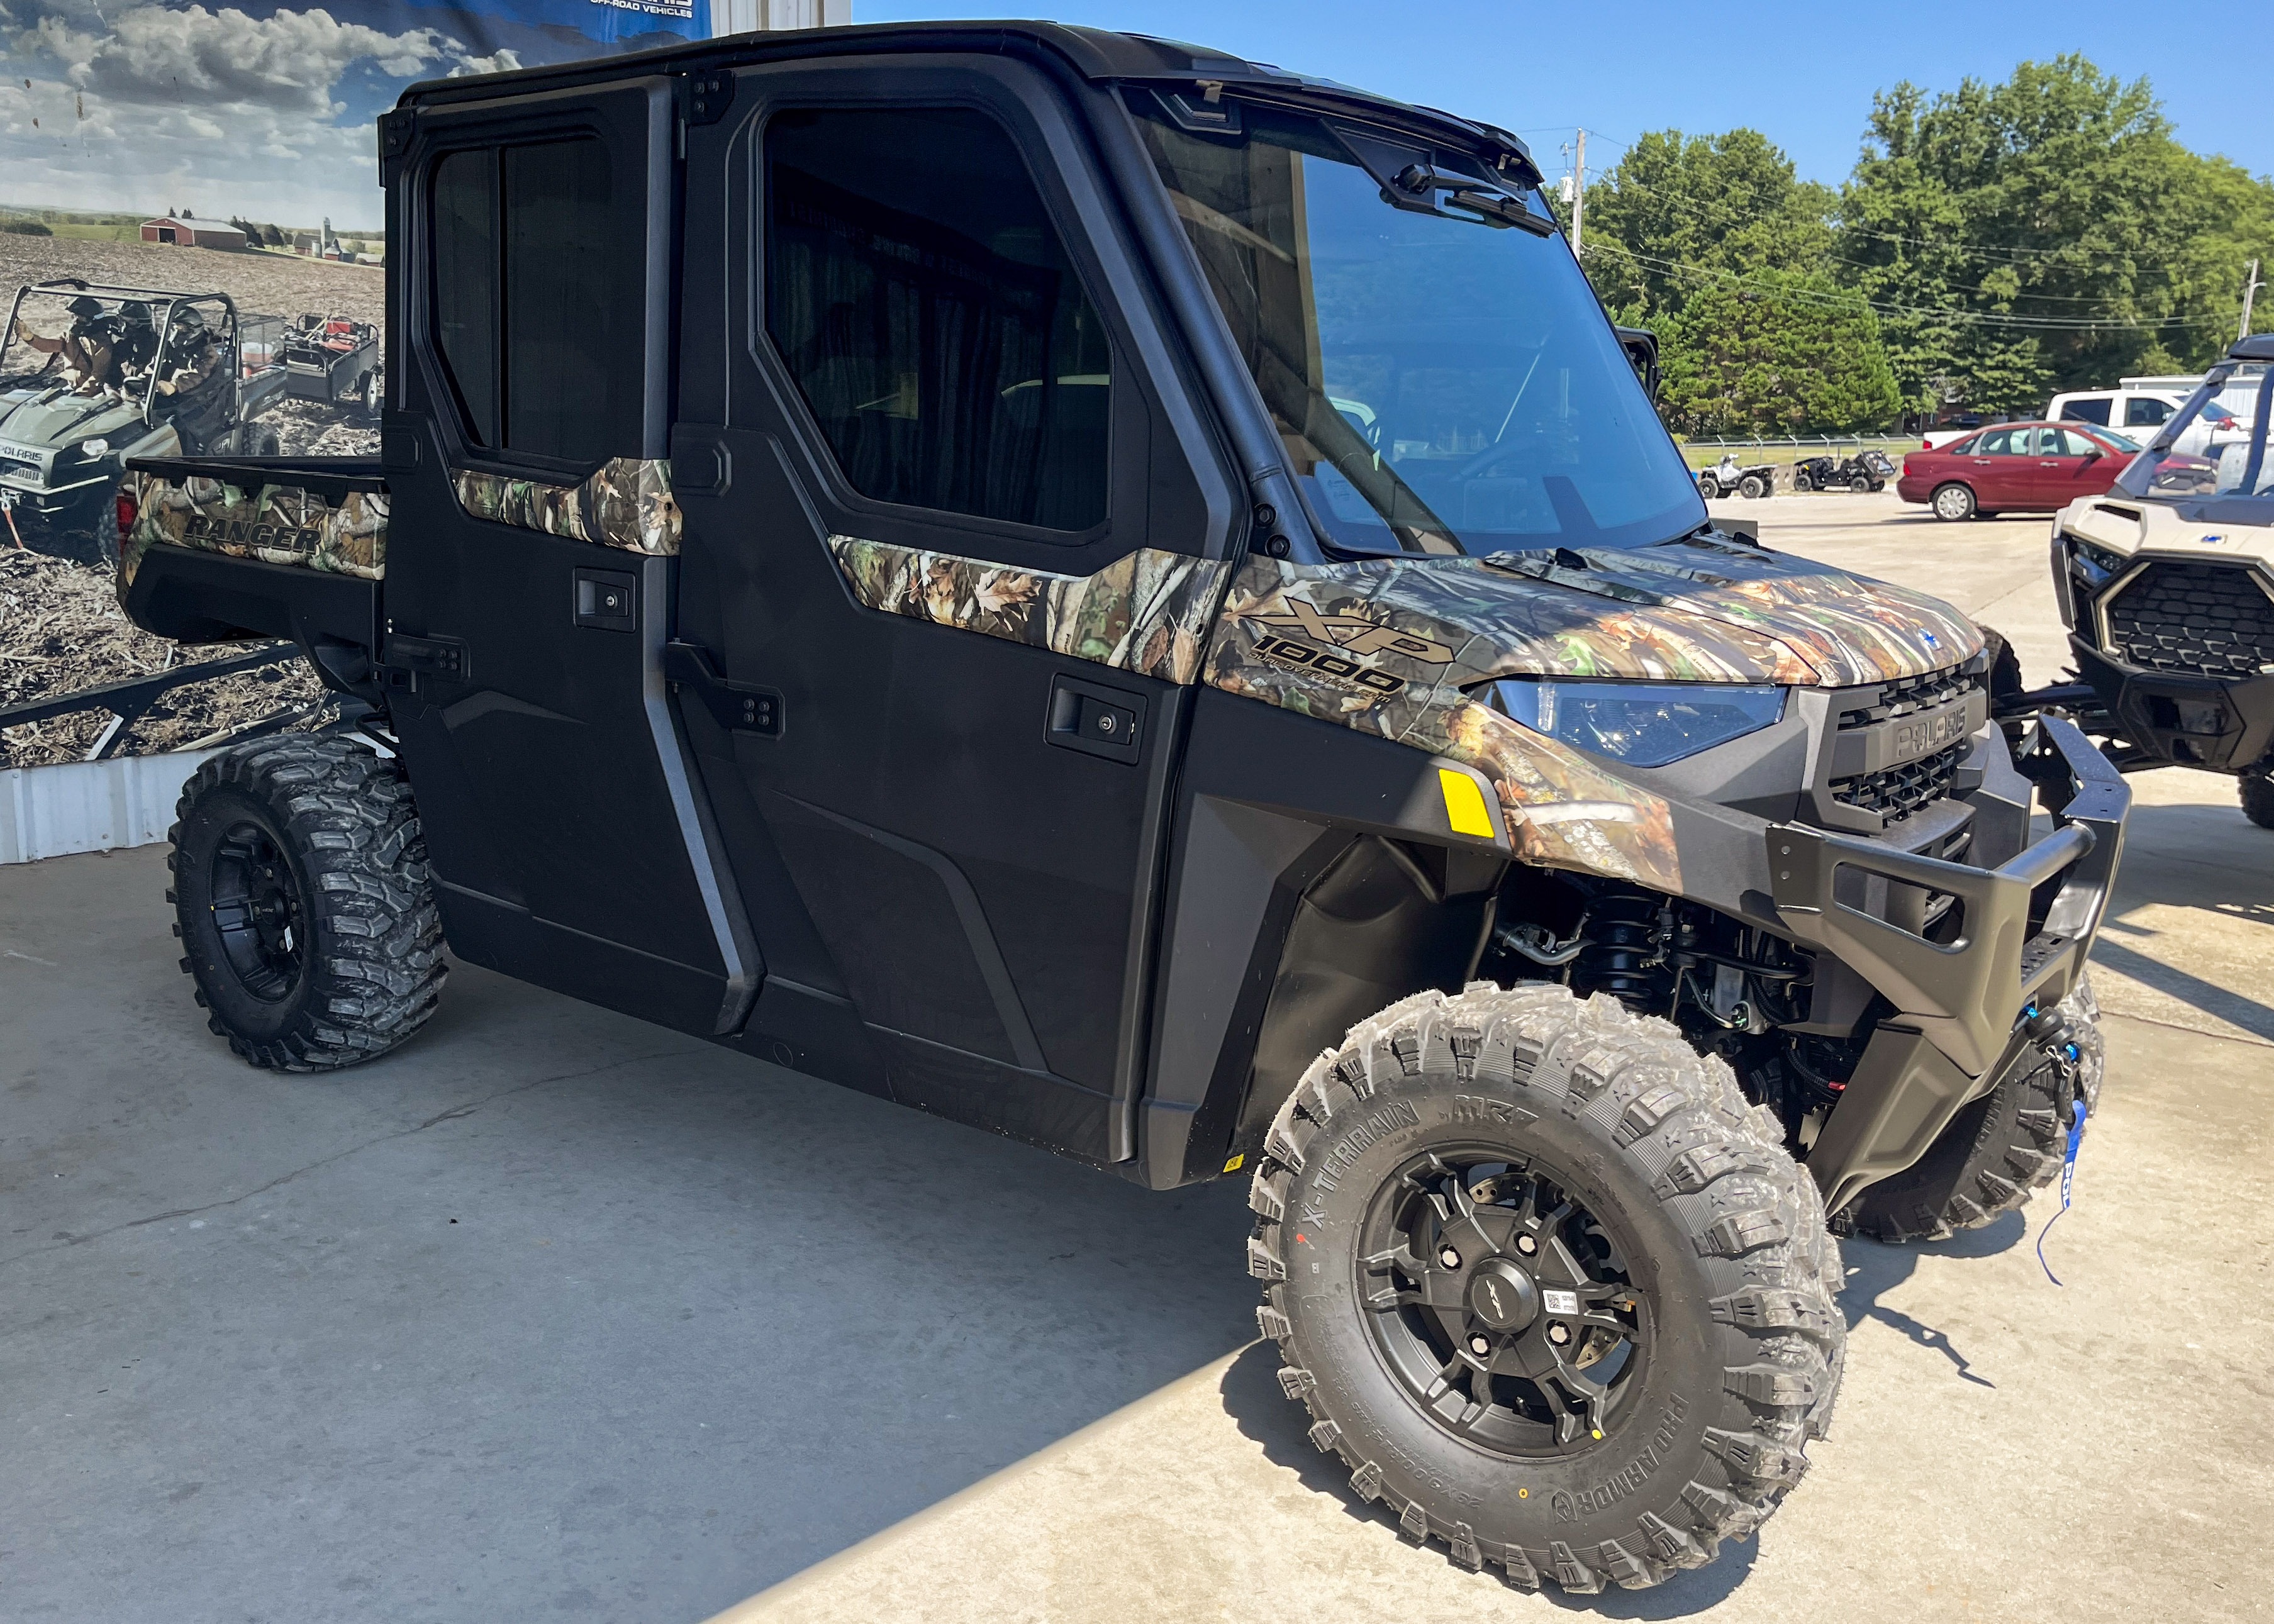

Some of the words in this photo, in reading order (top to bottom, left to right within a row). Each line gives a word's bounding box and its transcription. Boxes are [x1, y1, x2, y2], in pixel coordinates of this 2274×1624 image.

[642, 4, 693, 18] VEHICLES
[183, 513, 321, 555] RANGER
[1238, 595, 1456, 664] XP
[1251, 634, 1408, 694] 1000
[1897, 705, 1966, 758] POLARIS
[1301, 1099, 1420, 1230] X-TERRAIN
[1653, 1392, 1690, 1454] PRO
[1576, 1445, 1660, 1515] ARMOR
